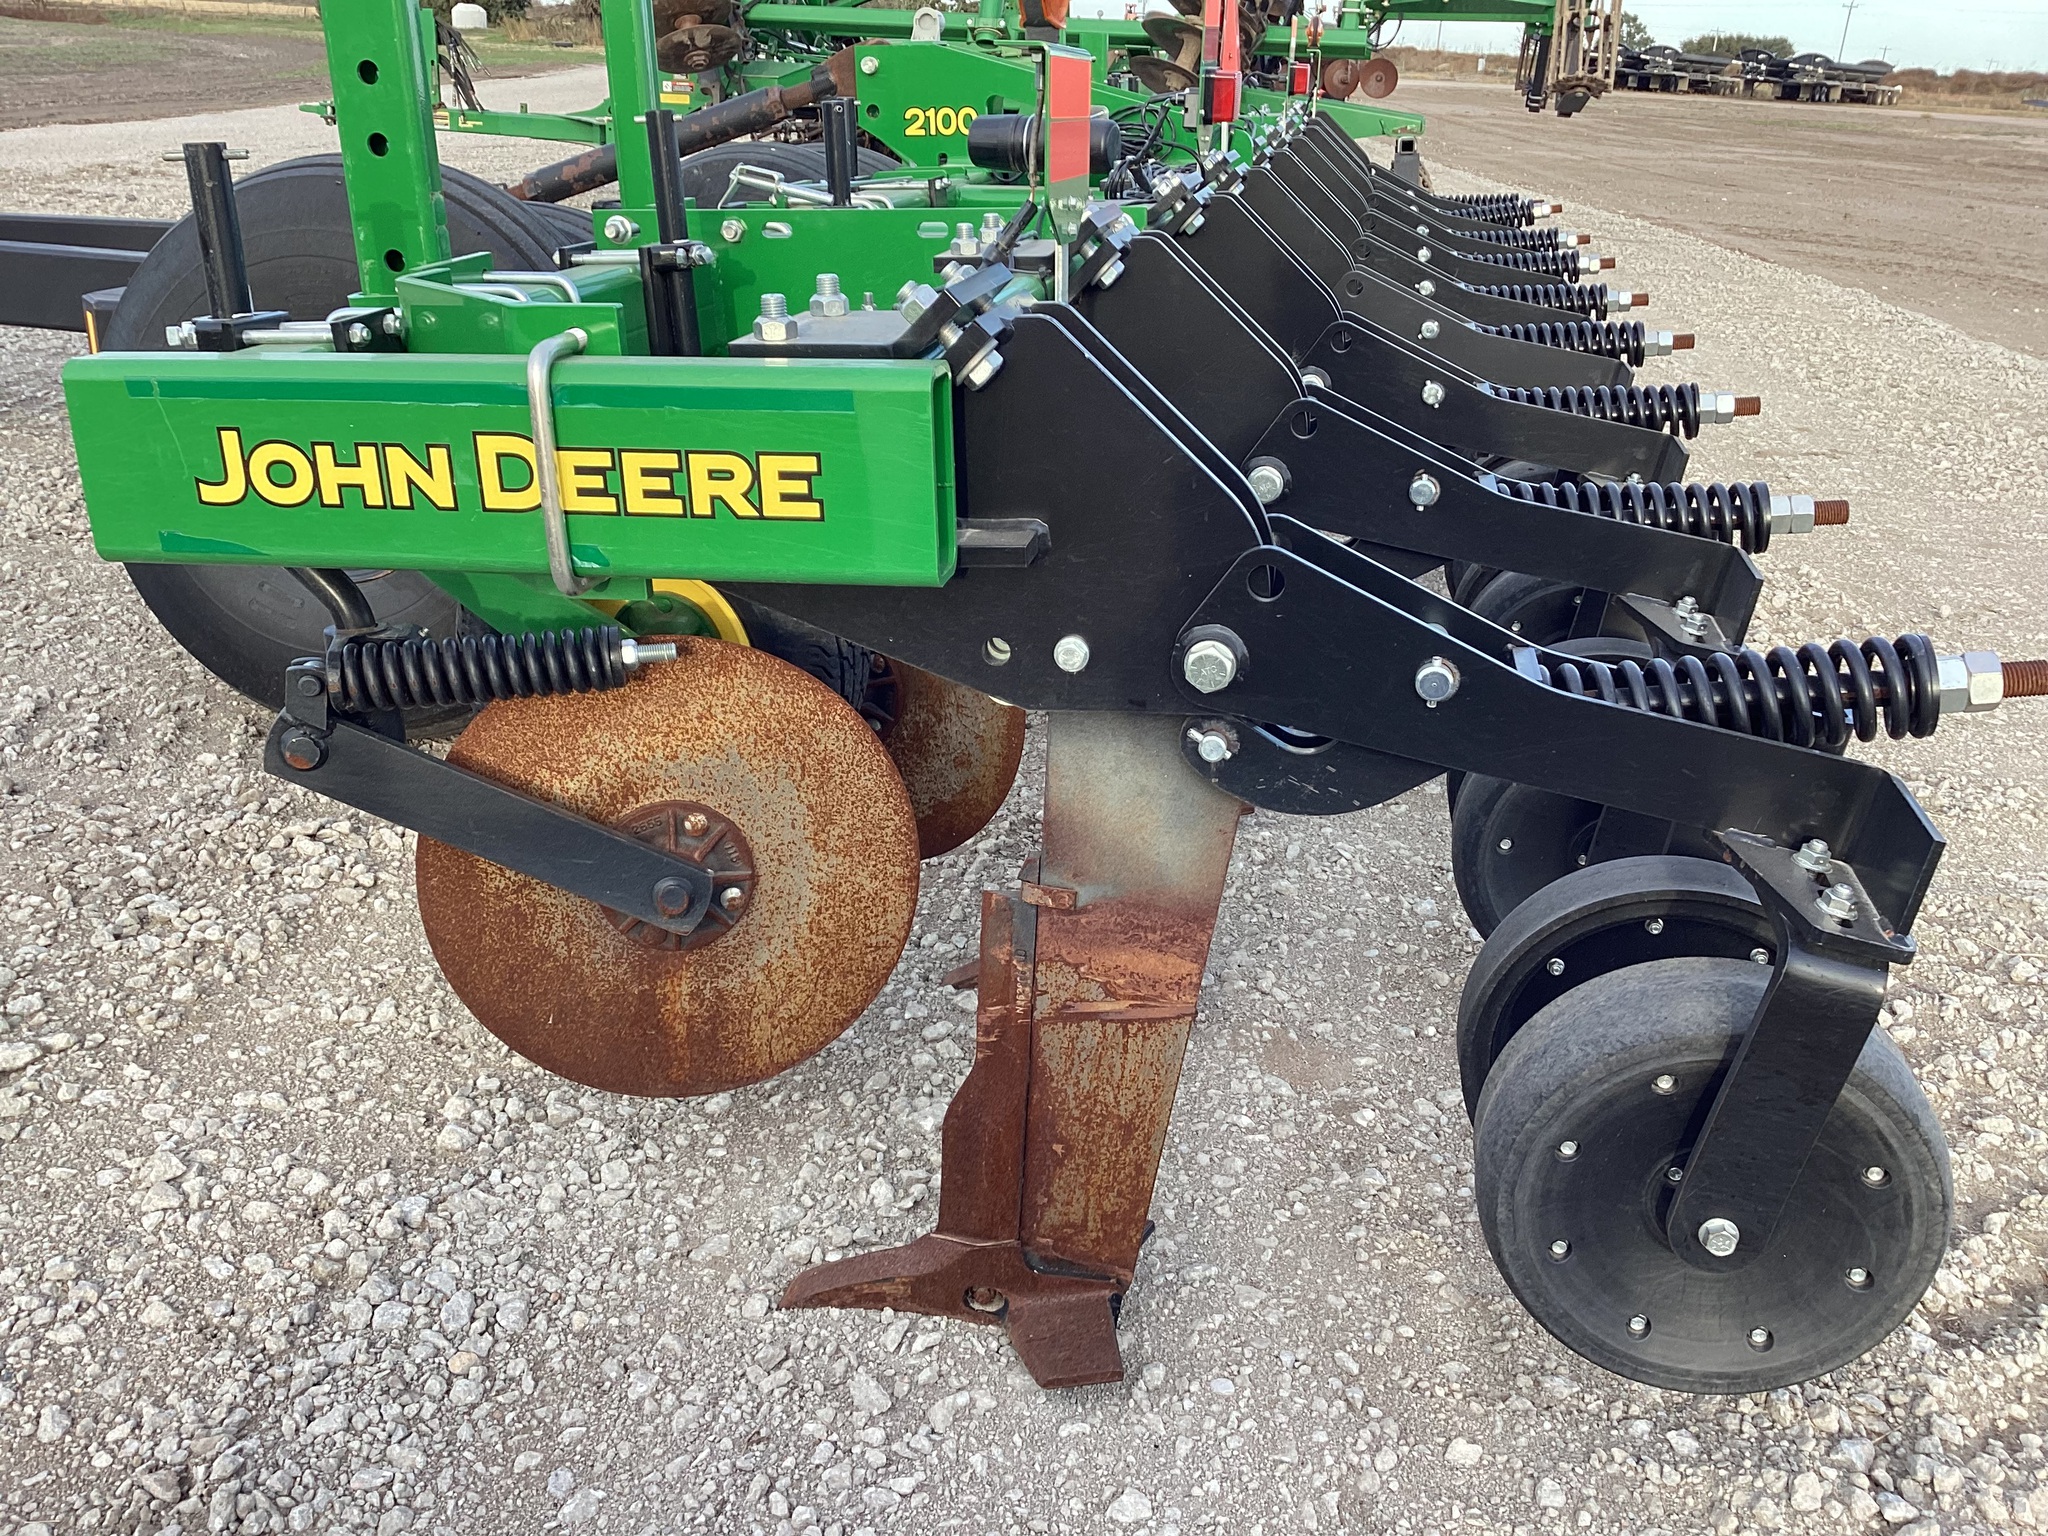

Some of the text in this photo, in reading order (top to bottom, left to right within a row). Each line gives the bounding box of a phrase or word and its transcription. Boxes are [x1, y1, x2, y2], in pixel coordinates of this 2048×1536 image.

[903, 106, 978, 137] 2100
[194, 427, 825, 522] JOHN DEERE
